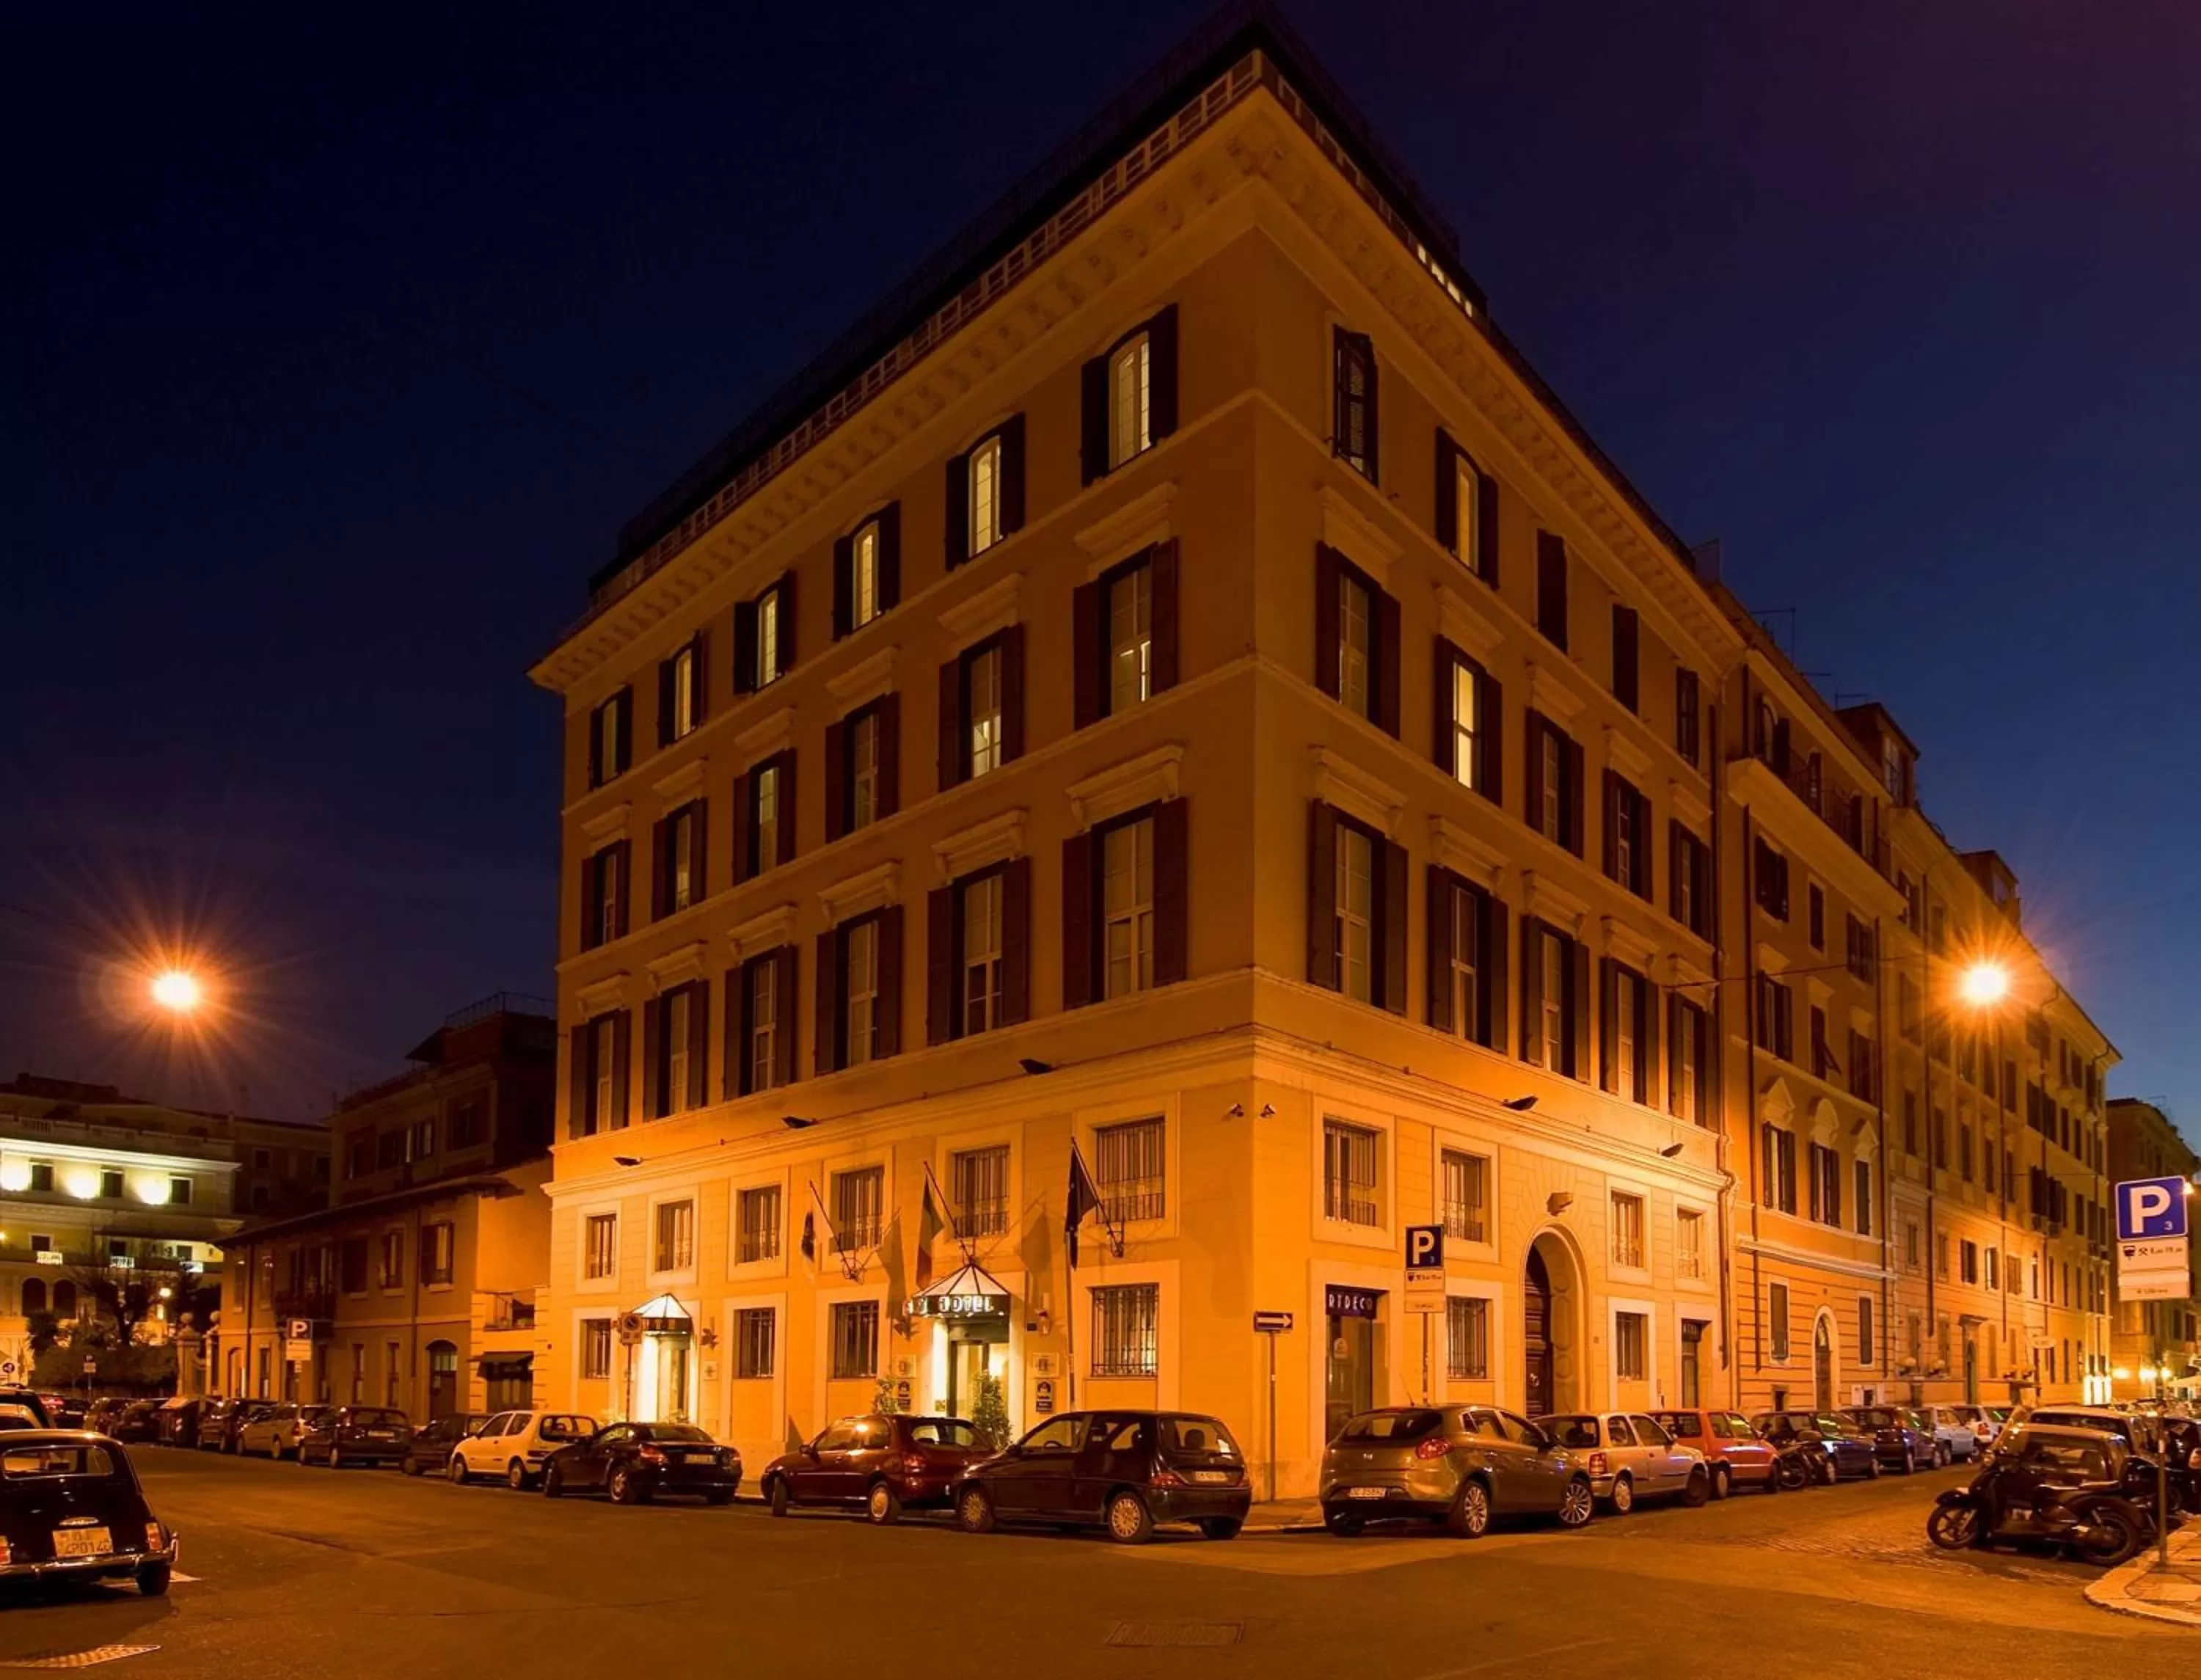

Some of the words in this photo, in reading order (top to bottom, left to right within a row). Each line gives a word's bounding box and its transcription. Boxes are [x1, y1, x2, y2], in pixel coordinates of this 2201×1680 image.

[2130, 1186, 2172, 1234] P
[2164, 1221, 2174, 1231] 3
[1412, 1230, 1434, 1265] P
[291, 1321, 308, 1337] P
